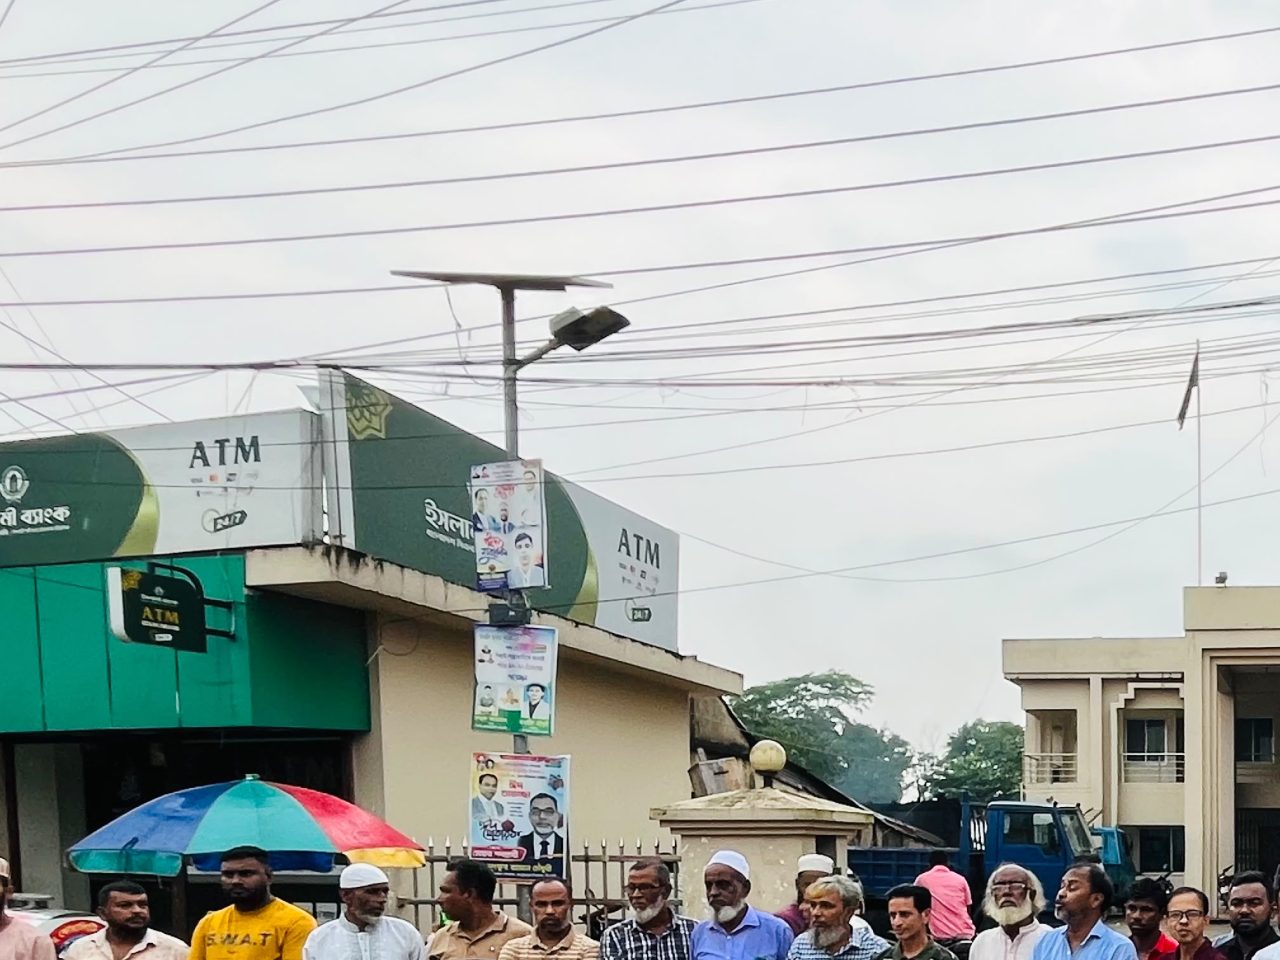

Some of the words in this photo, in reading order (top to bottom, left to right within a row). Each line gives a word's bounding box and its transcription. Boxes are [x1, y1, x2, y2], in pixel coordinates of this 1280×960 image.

[189, 436, 261, 468] ATM
[20, 505, 71, 526] ব্যাংক
[215, 513, 243, 531] 24/7
[424, 498, 476, 541] ইসলা
[617, 528, 660, 570] ATM
[143, 606, 179, 625] ATM
